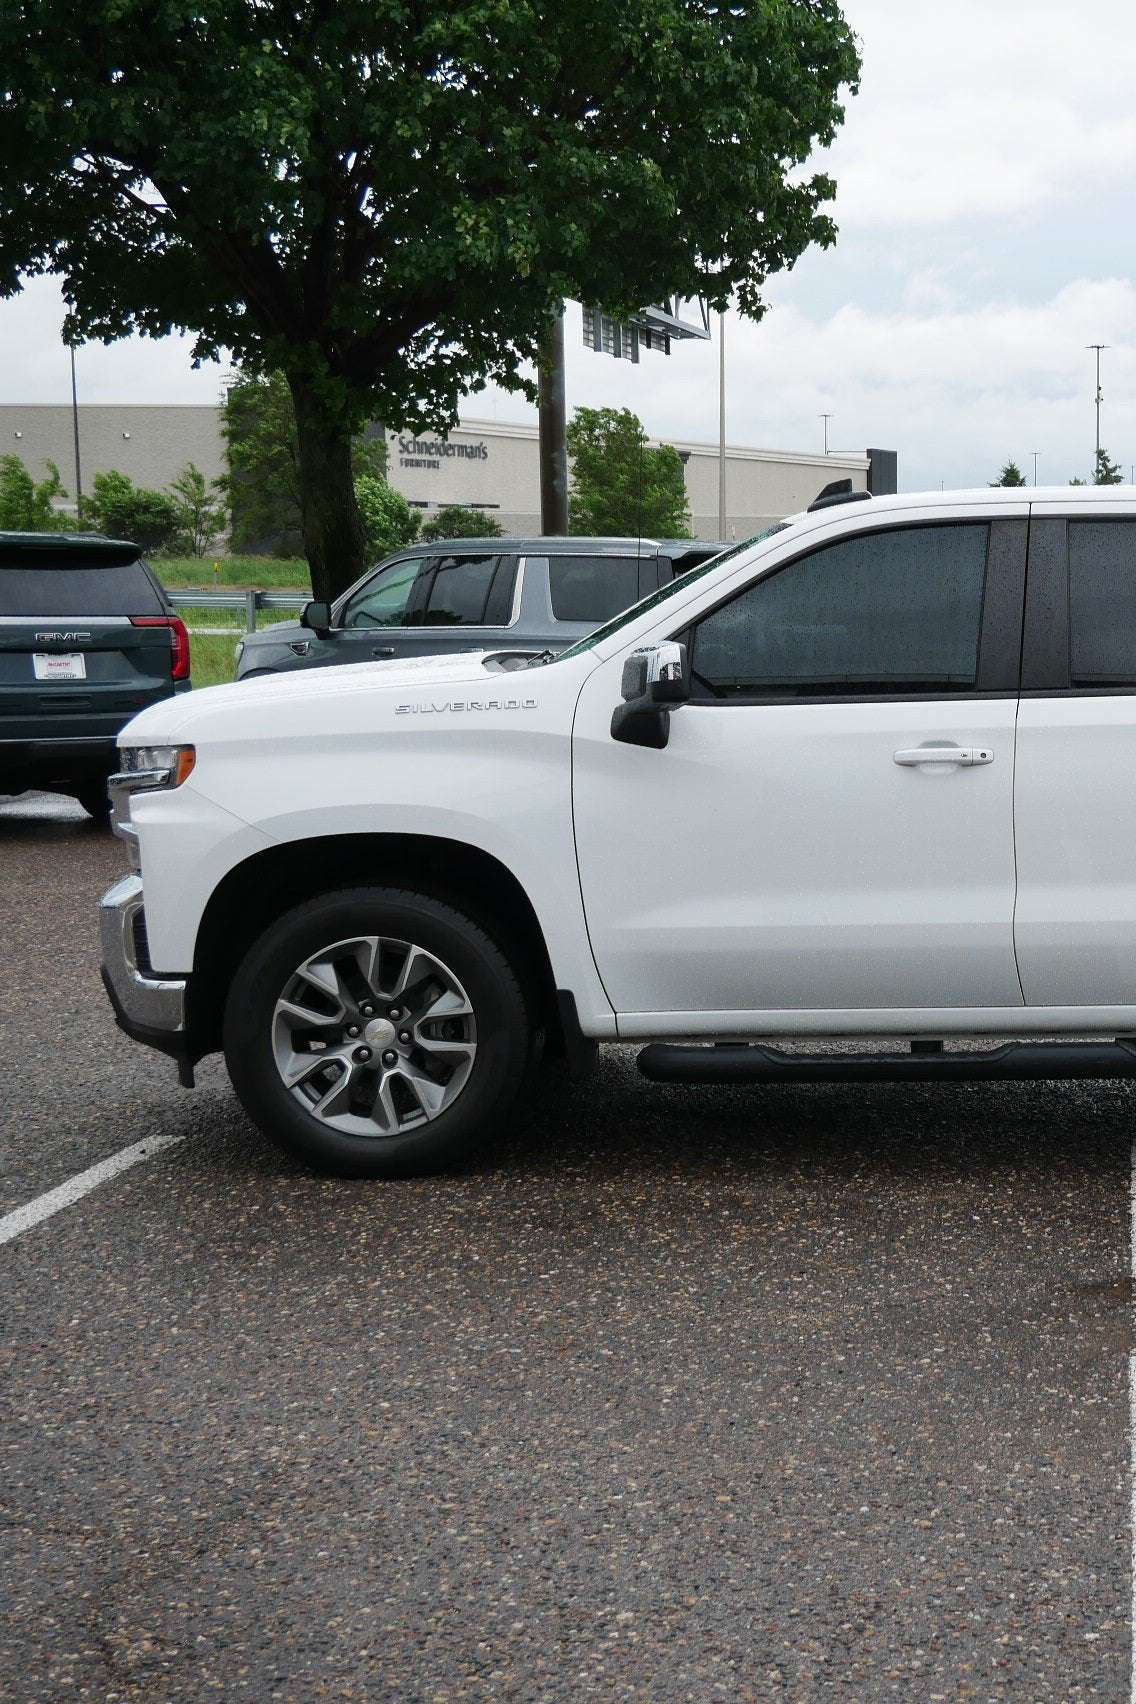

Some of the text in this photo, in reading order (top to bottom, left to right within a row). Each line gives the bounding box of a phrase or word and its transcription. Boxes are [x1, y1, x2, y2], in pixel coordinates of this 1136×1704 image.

[398, 435, 489, 460] Schneiderman's
[400, 457, 441, 469] FURNITURE
[35, 632, 91, 643] GMC
[394, 699, 538, 715] SILVERADO
